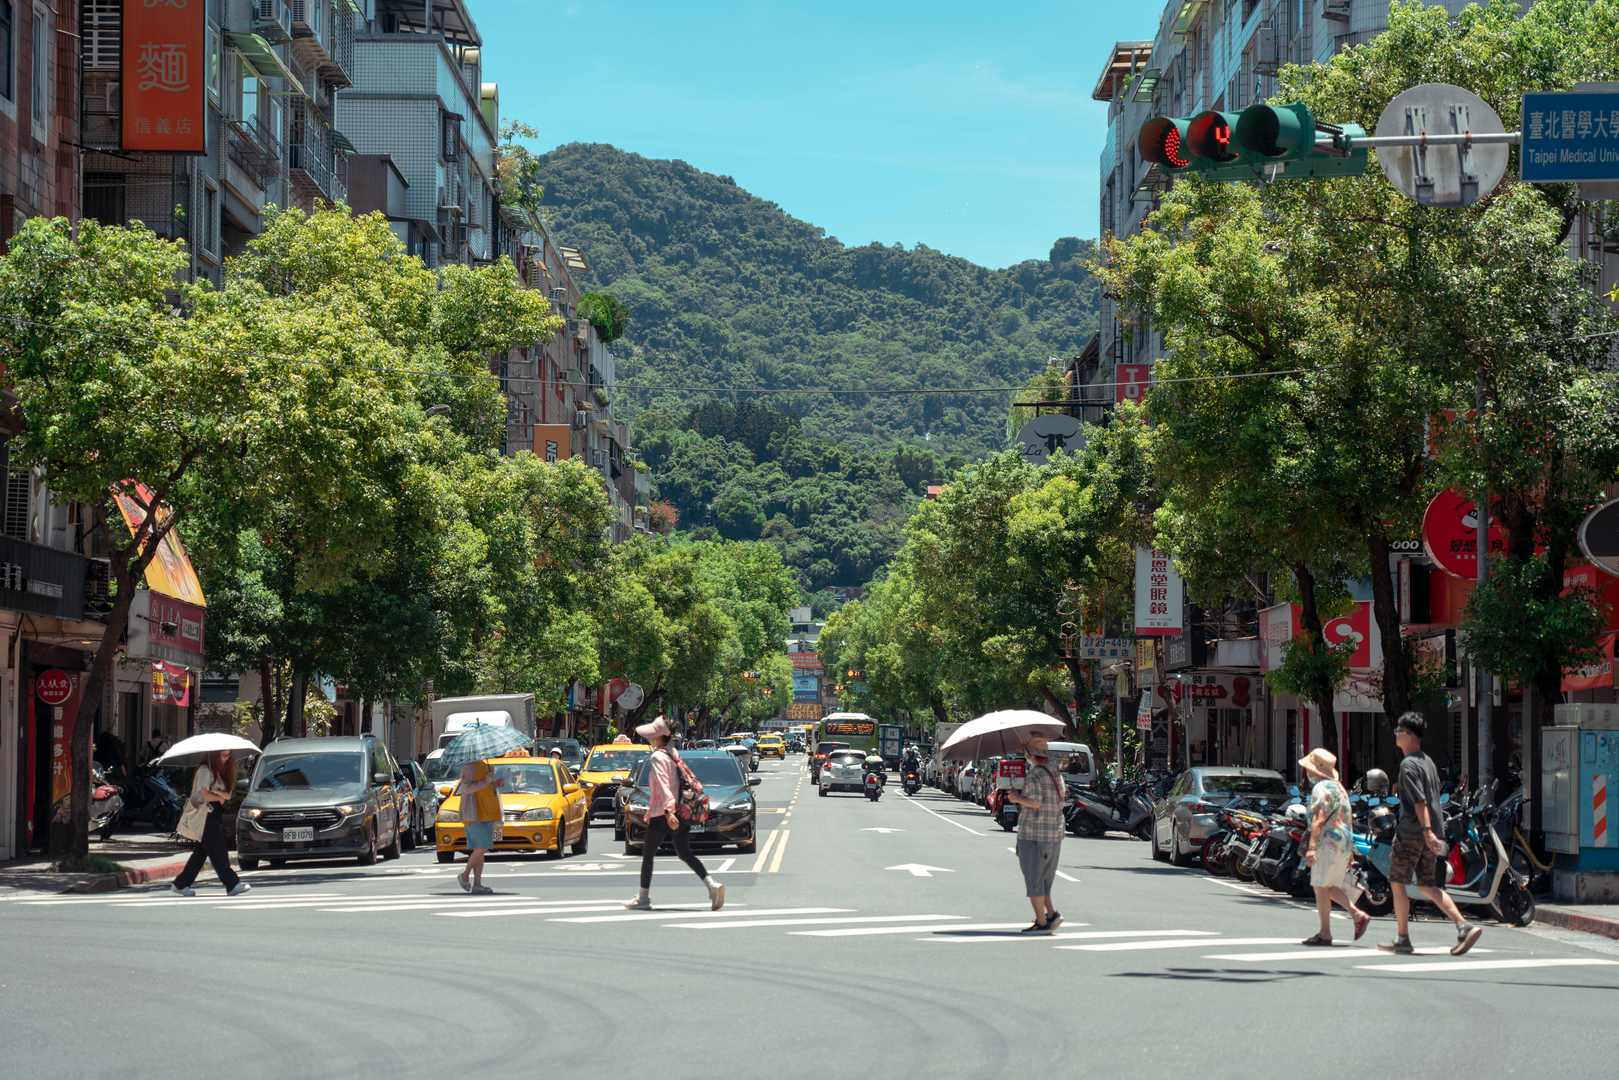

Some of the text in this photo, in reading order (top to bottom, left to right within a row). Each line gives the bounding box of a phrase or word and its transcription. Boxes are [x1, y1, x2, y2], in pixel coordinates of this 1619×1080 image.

[134, 117, 192, 135] 信義店
[1529, 110, 1619, 139] 臺北醫學大學
[1528, 148, 1557, 167] Taipei
[1560, 148, 1596, 163] Medical
[1125, 368, 1139, 403] TO
[1449, 539, 1506, 553] 好想魚
[1084, 637, 1132, 647] 2729-4497
[827, 723, 838, 732] 77
[53, 706, 64, 776] 香嫩多汁
[284, 831, 313, 840] RFB-1078
